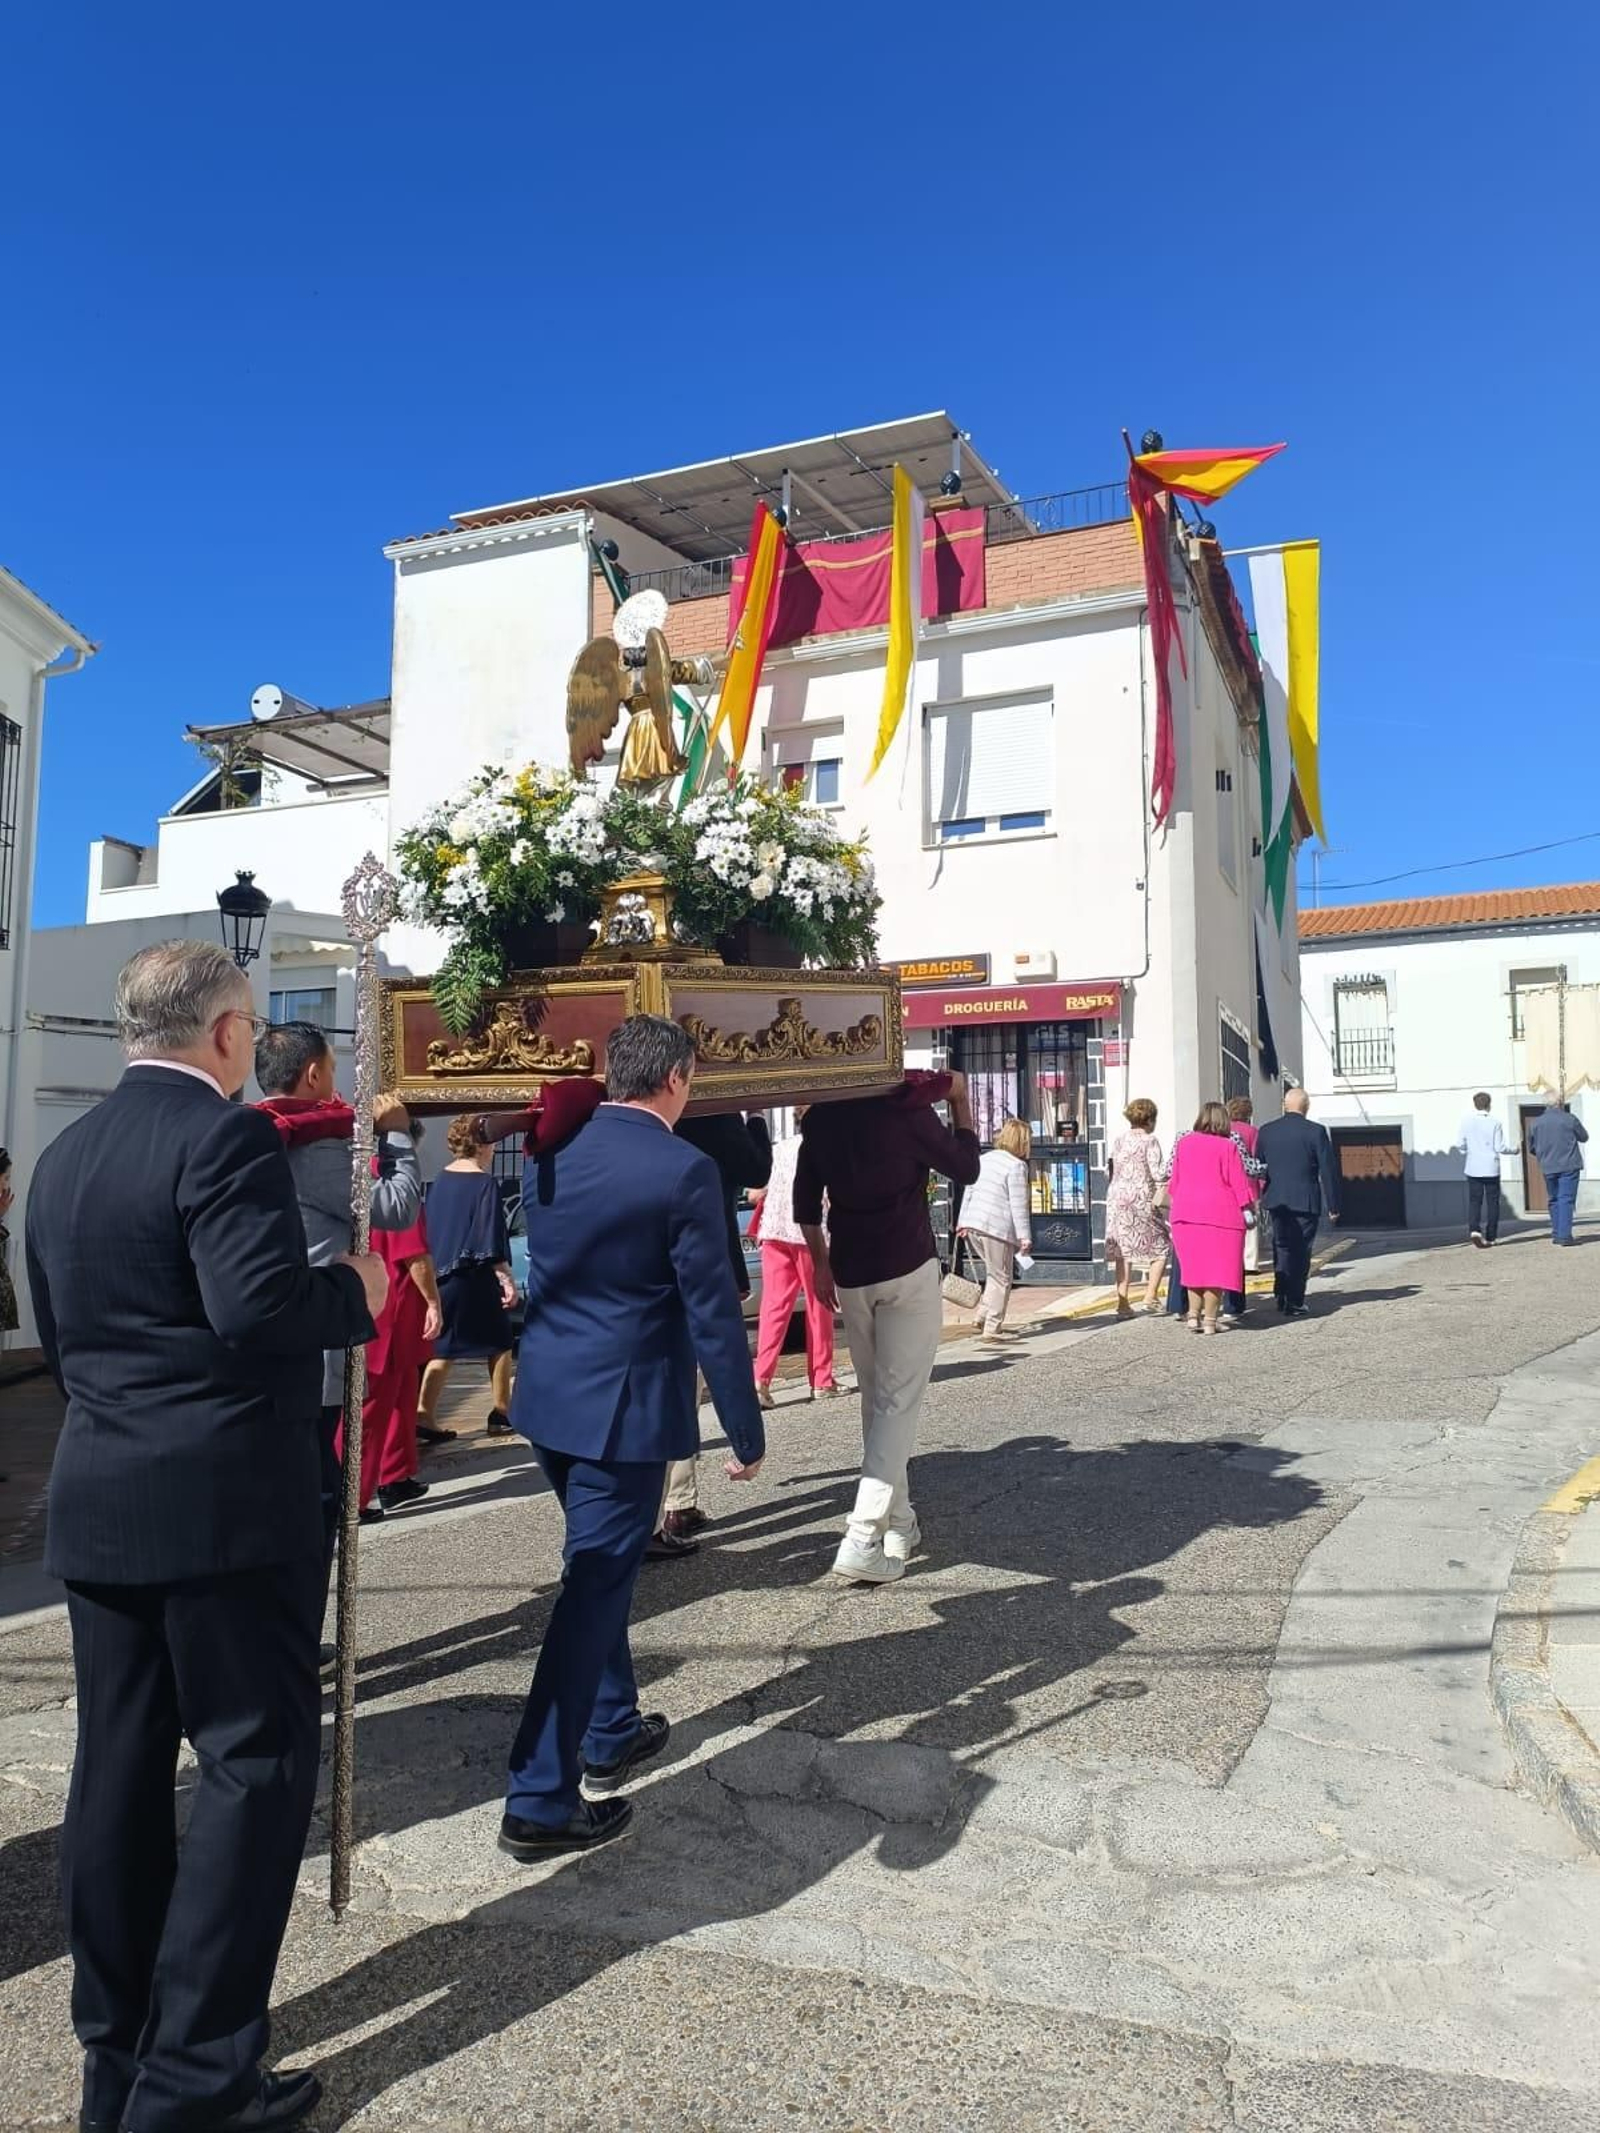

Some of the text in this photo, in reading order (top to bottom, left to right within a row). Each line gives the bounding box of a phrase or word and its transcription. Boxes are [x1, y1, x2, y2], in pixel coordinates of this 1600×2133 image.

[899, 960, 974, 977] TABACOS
[944, 997, 1028, 1015] DROGUERÍA
[1066, 994, 1114, 1010] RASTA
